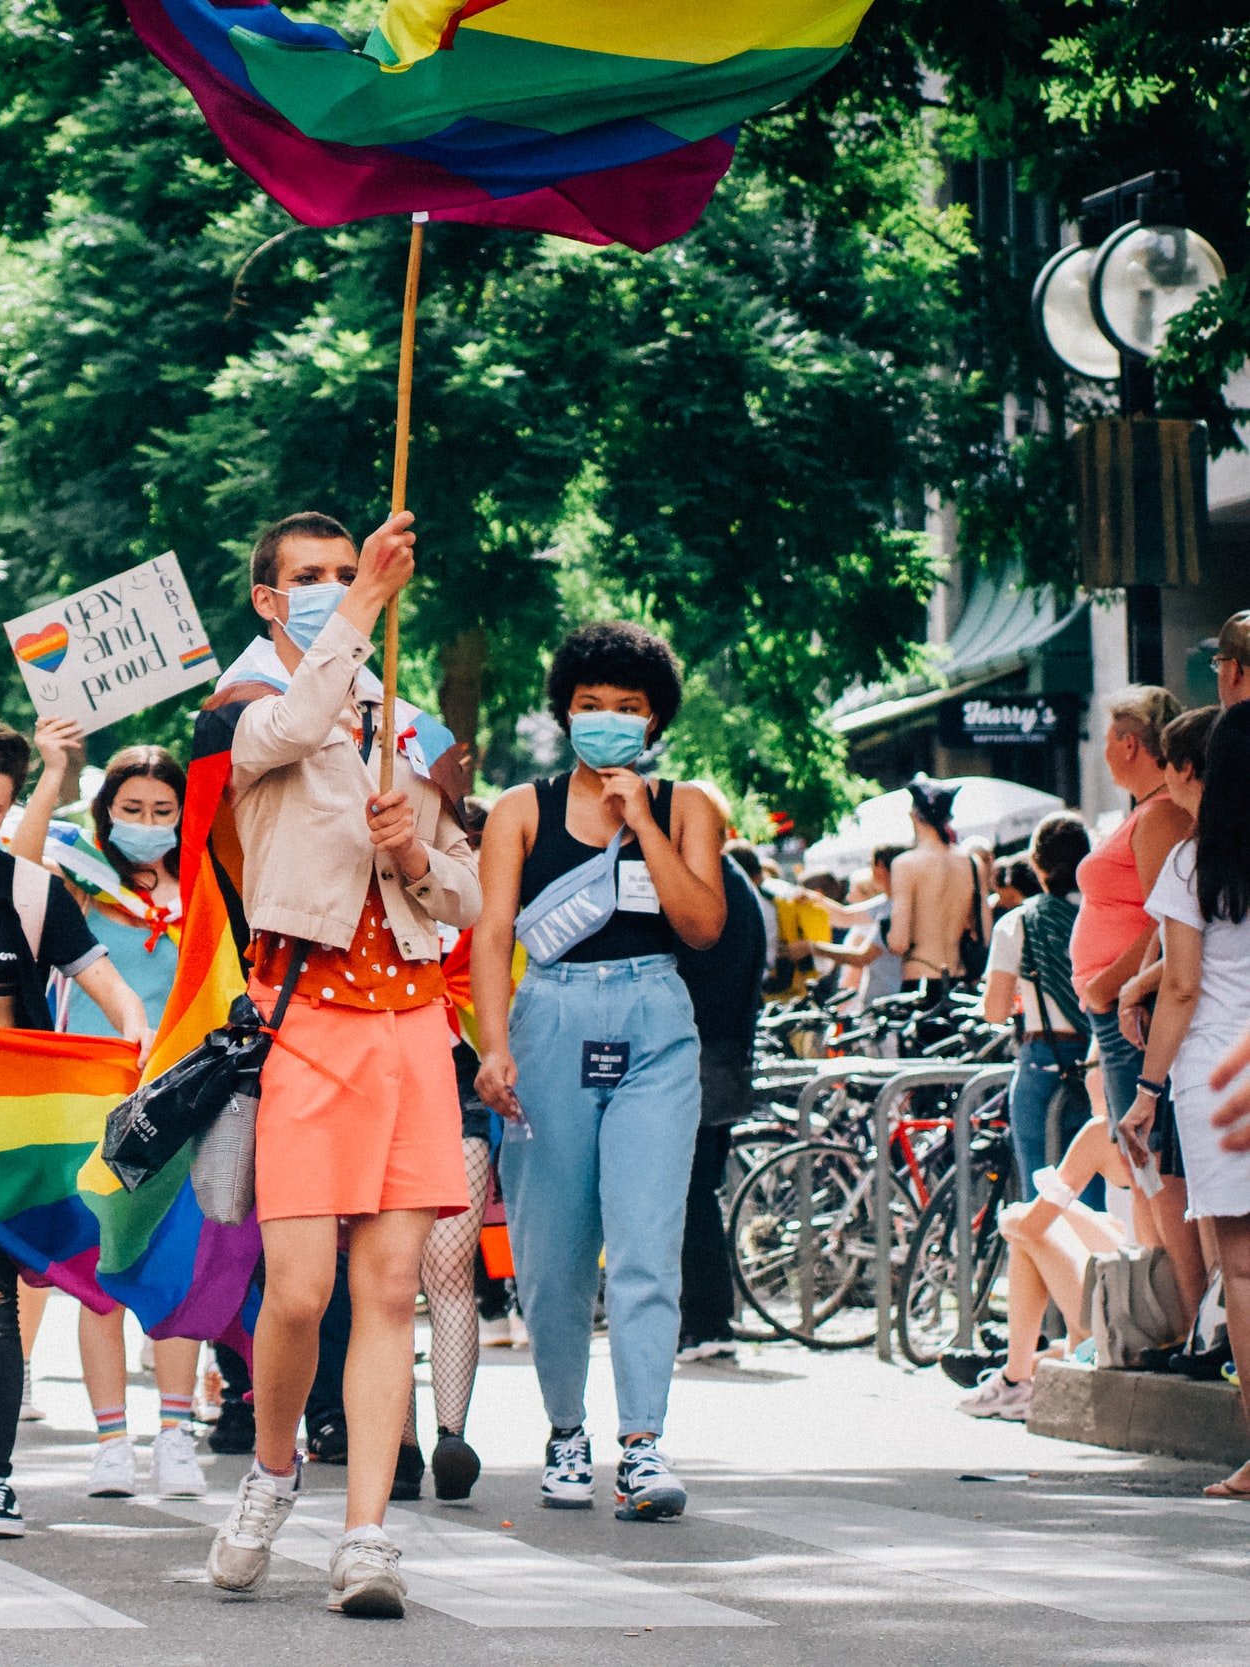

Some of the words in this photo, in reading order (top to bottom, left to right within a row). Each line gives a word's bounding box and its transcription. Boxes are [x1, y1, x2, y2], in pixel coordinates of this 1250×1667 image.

[65, 583, 123, 640] gay
[83, 607, 147, 664] and
[81, 632, 167, 711] proud
[963, 699, 1057, 733] Harry's
